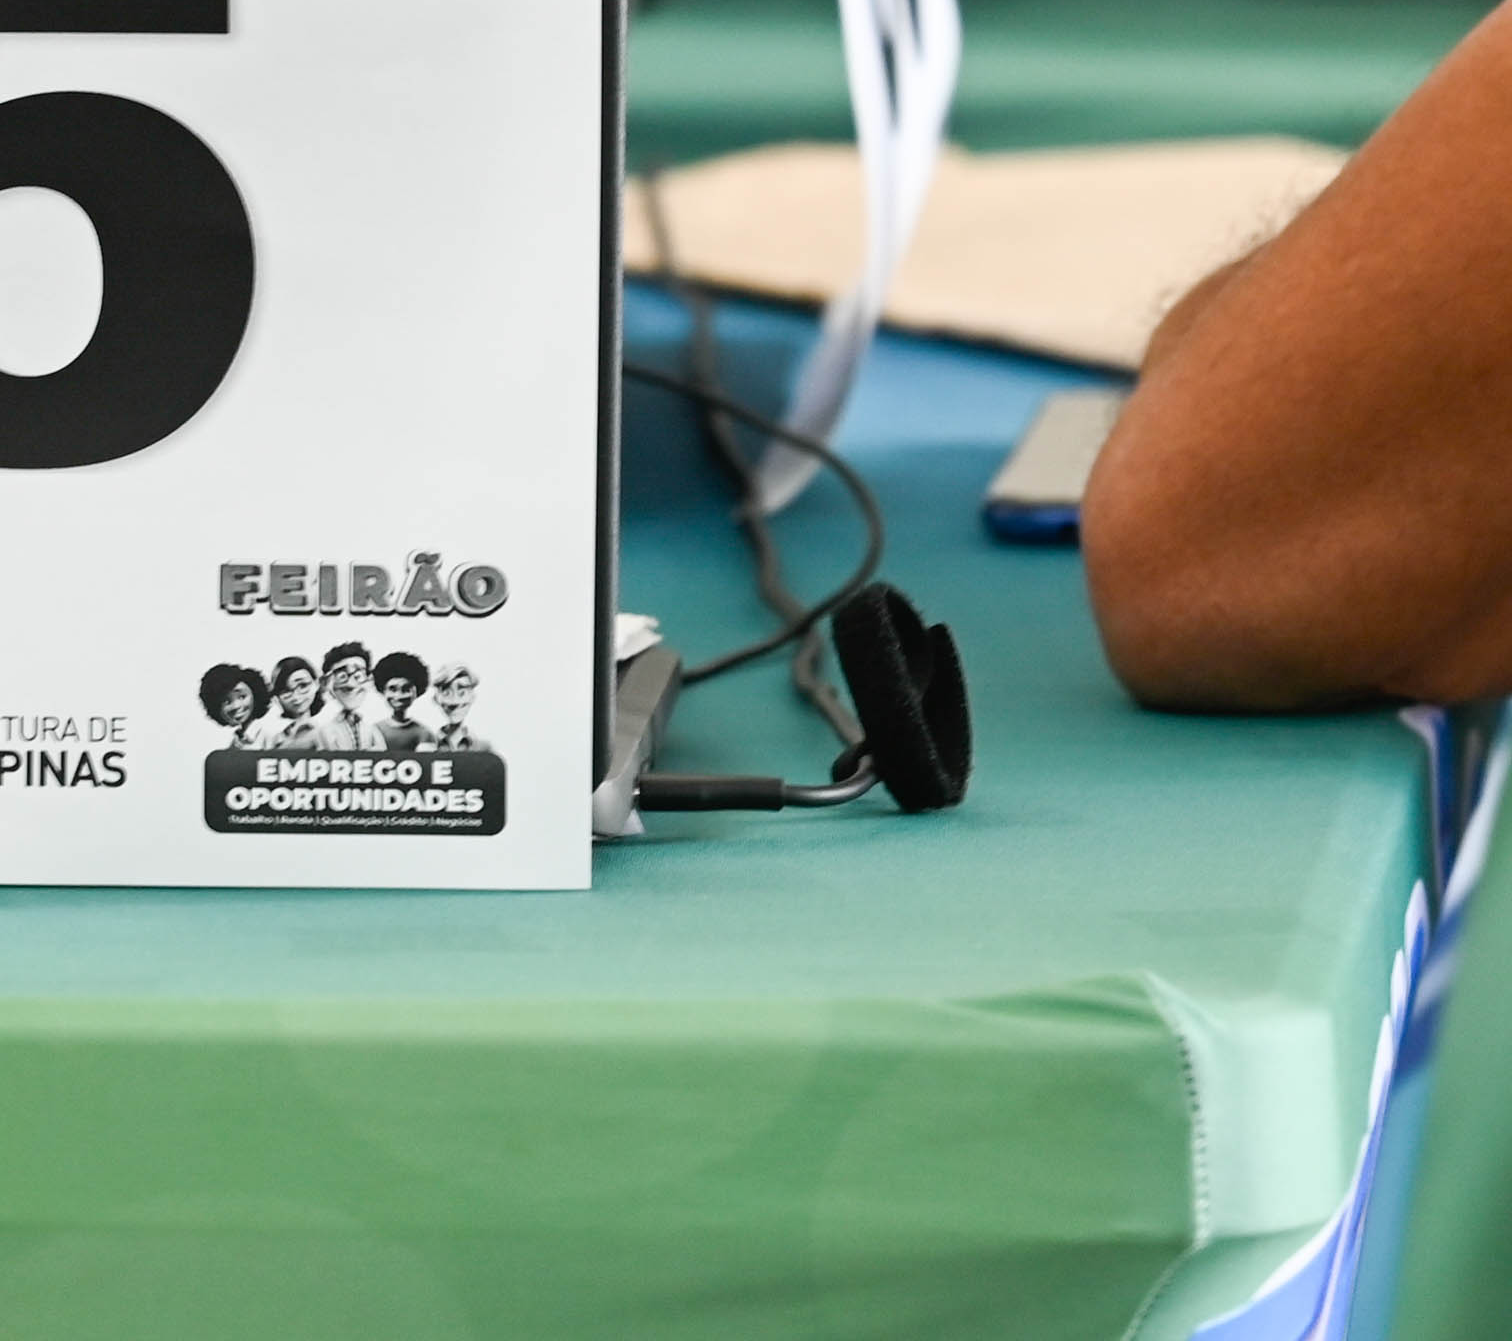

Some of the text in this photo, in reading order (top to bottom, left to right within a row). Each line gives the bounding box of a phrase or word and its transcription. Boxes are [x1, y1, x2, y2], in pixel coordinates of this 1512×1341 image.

[219, 550, 509, 619] FEIRÃO
[88, 716, 127, 743] DE
[256, 758, 453, 785] EMPREGO E
[225, 786, 484, 813] OPORTUNIDADES
